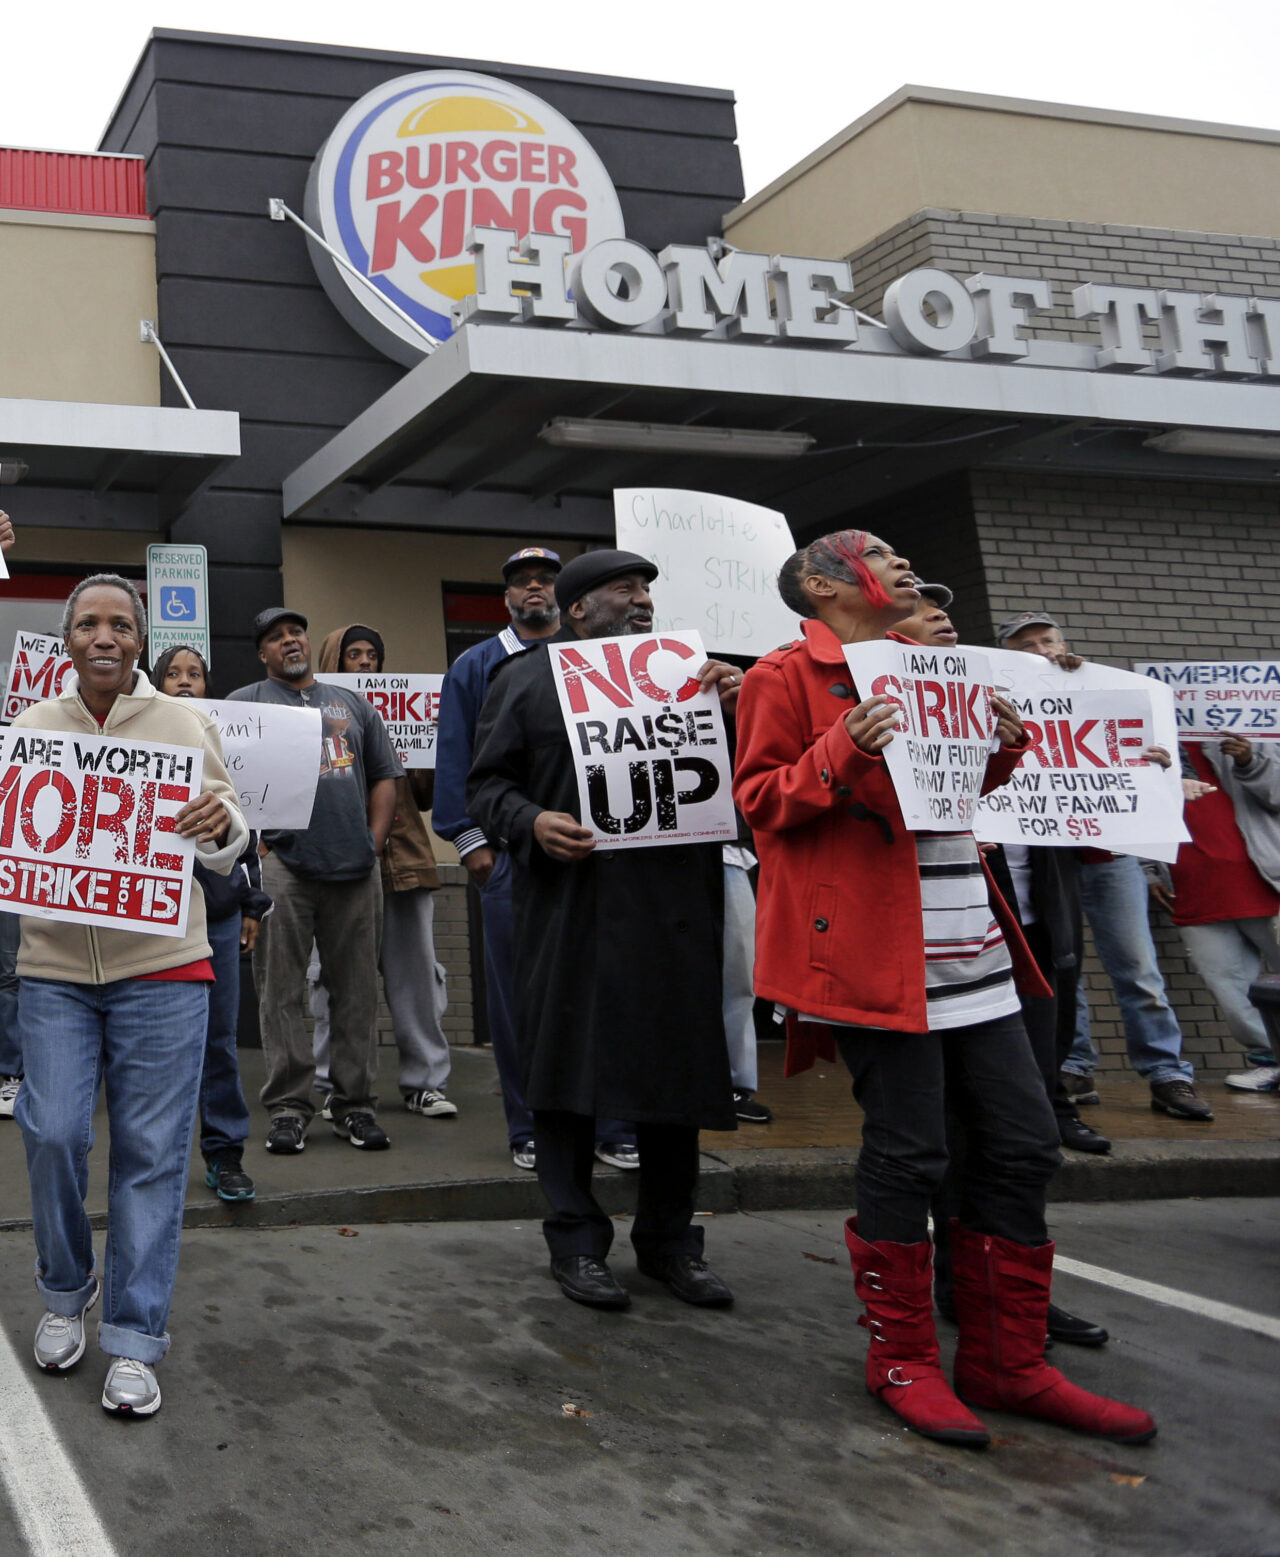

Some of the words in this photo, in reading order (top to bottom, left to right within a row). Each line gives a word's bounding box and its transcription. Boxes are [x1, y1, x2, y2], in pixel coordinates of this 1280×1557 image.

[365, 139, 580, 201] BURGER
[370, 187, 587, 274] KING
[456, 225, 859, 349] HOME
[883, 267, 1053, 362] OF
[631, 494, 757, 543] Charlotte
[151, 552, 202, 565] RESERVED
[154, 568, 200, 580] PARKING
[704, 602, 754, 640] $15
[20, 636, 46, 654] WE
[153, 631, 205, 641] MAXIMUM
[902, 652, 908, 672] I
[911, 654, 938, 675] AM
[944, 656, 967, 677] ON
[1146, 665, 1280, 684] AMERICA
[357, 679, 361, 688] I
[365, 678, 386, 689] AM
[390, 679, 408, 689] ON
[558, 638, 701, 714] NC
[1039, 698, 1072, 715] ON
[1205, 690, 1280, 701] SURVIVE
[1205, 704, 1278, 731] $7.25
[387, 724, 434, 736] FUTURE
[10, 736, 64, 767] ARE
[73, 742, 193, 783] WORTH
[921, 744, 942, 766] MY
[925, 771, 946, 793] MY
[1011, 774, 1040, 791] MY
[1049, 773, 1136, 791] FUTURE
[585, 757, 720, 835] UP
[1018, 796, 1047, 814] MY
[1056, 794, 1138, 814] FAMILY
[929, 798, 953, 820] FOR
[655, 832, 691, 840] ORGANIZING
[692, 829, 731, 837] COMMITTEE
[1018, 817, 1061, 837] FOR
[1066, 815, 1102, 840] $15
[116, 876, 132, 914] FOR
[135, 878, 182, 920] 15
